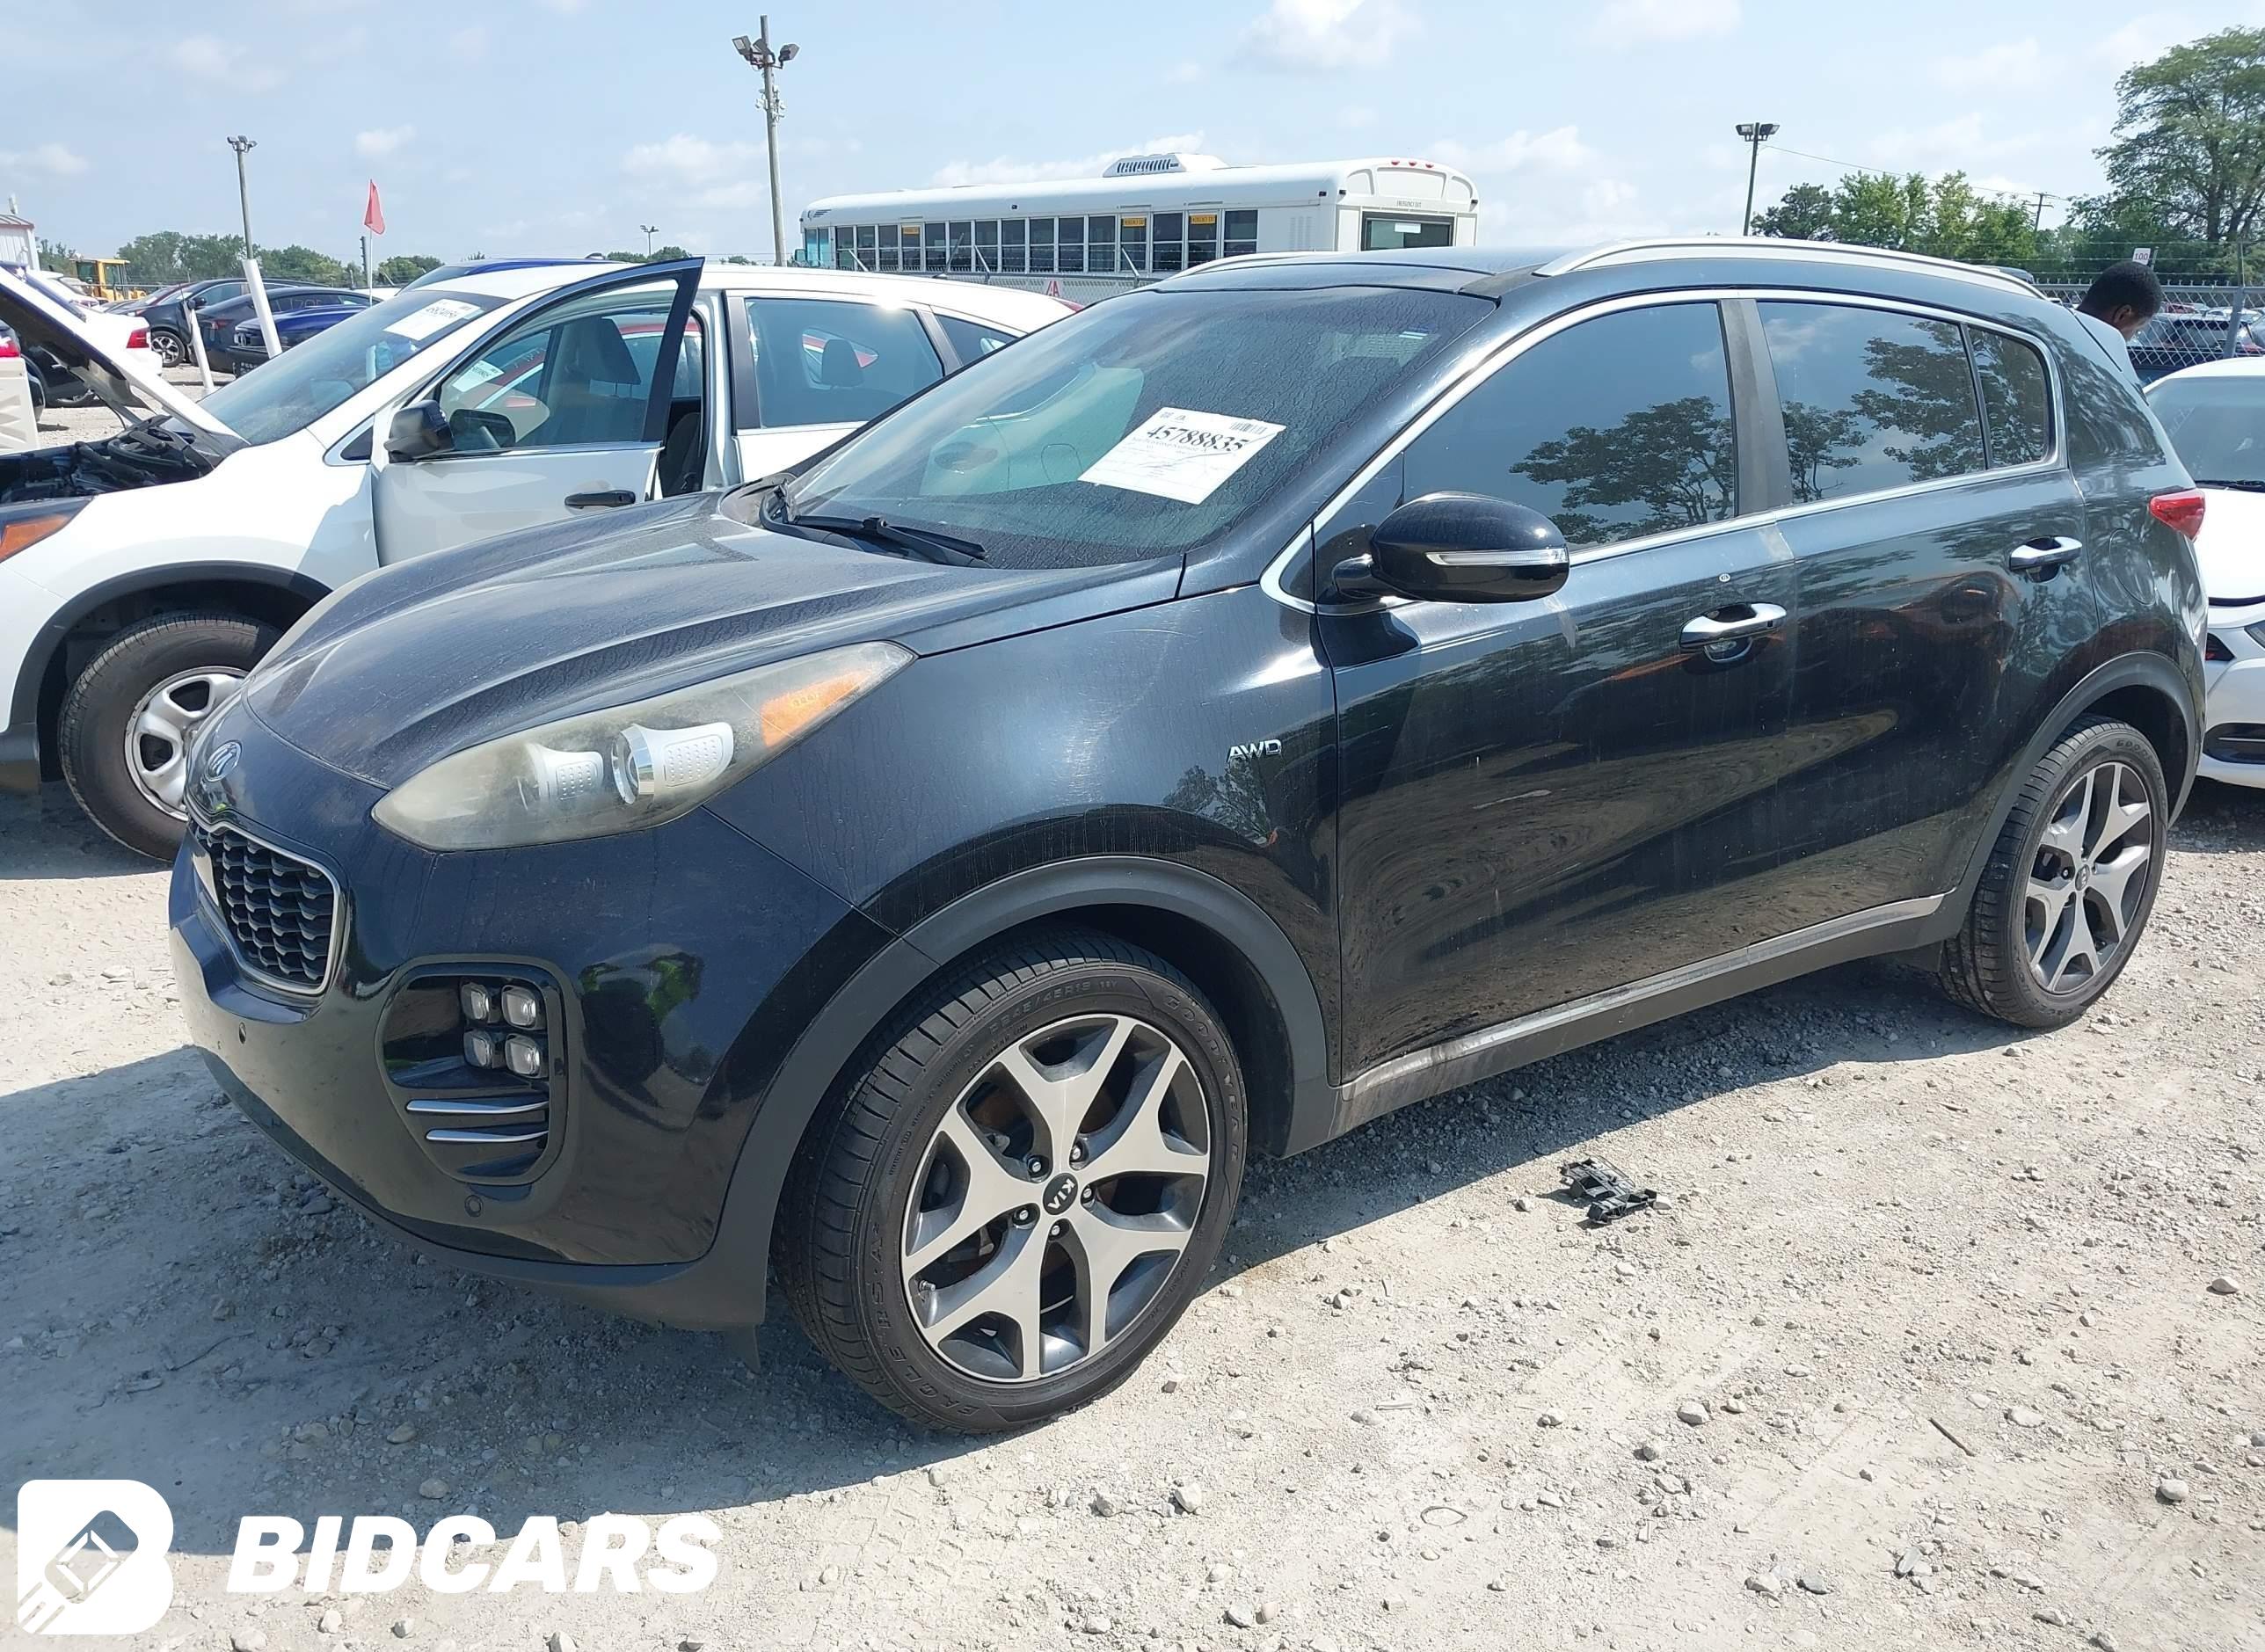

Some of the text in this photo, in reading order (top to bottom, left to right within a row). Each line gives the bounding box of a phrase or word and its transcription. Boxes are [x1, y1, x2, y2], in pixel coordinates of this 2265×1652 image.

[1147, 425, 1249, 453] 45788835
[1227, 739, 1282, 762] AWD
[1163, 993, 1241, 1162] GOODYEAR
[1047, 1178, 1075, 1209] KIA
[888, 1345, 981, 1416] EAGLE
